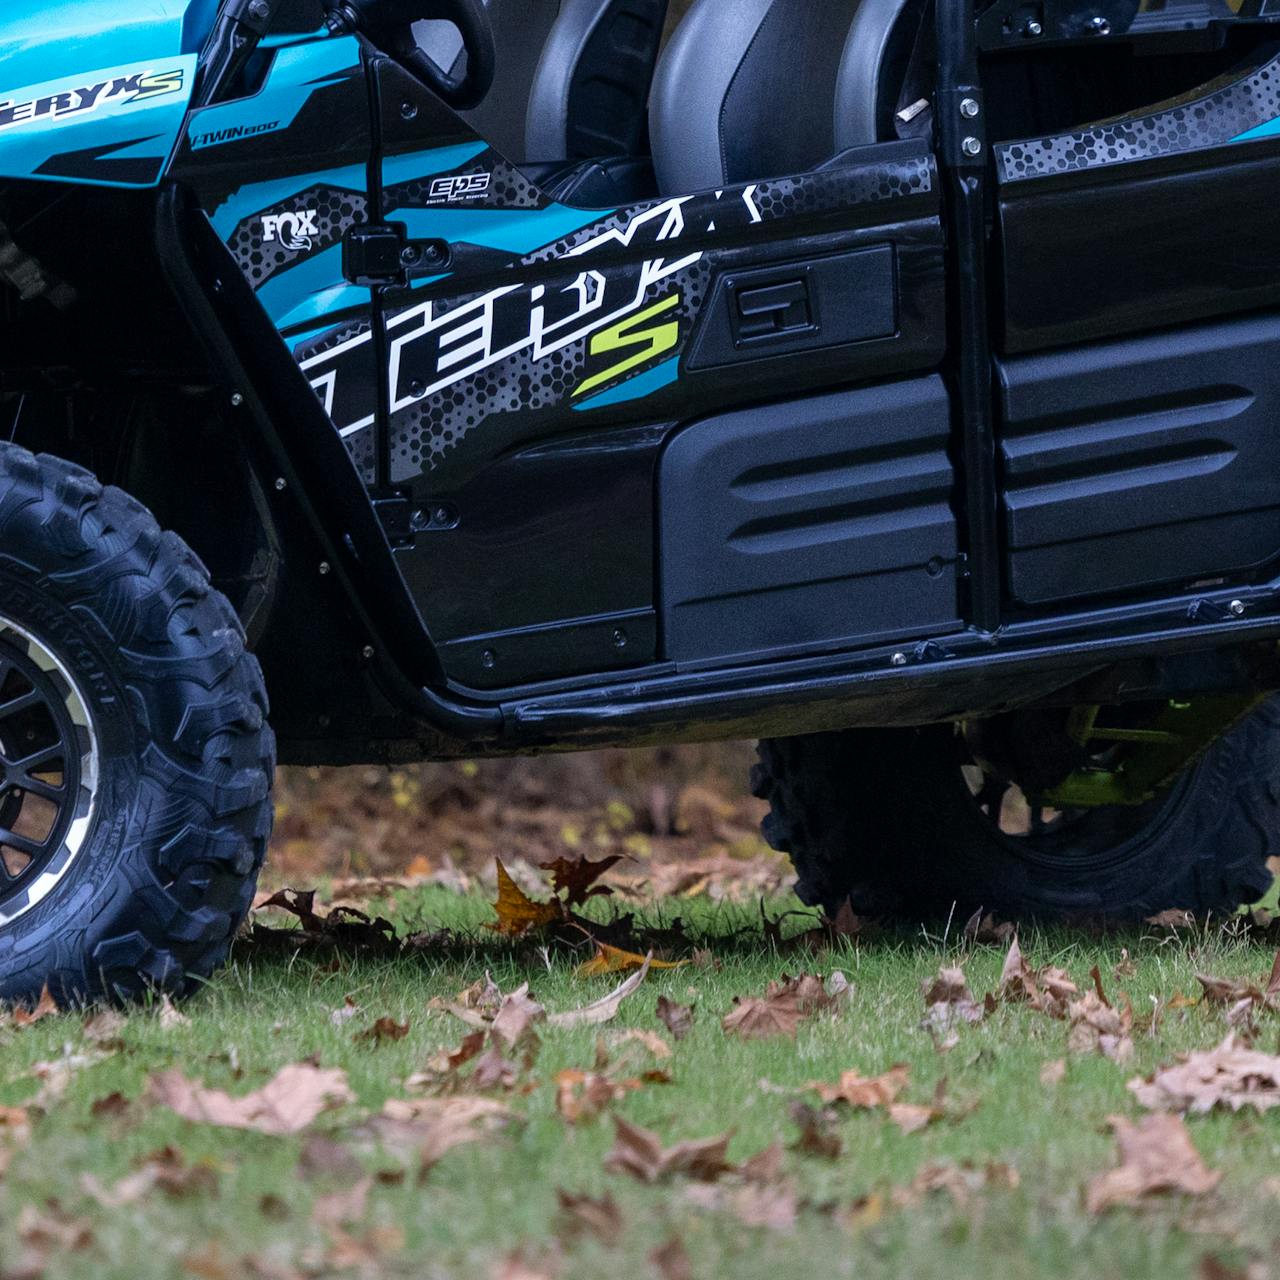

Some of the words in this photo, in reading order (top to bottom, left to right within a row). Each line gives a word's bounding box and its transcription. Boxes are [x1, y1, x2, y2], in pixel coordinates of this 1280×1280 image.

[243, 120, 281, 135] 800
[428, 172, 491, 199] EPS
[260, 209, 319, 252] FOX
